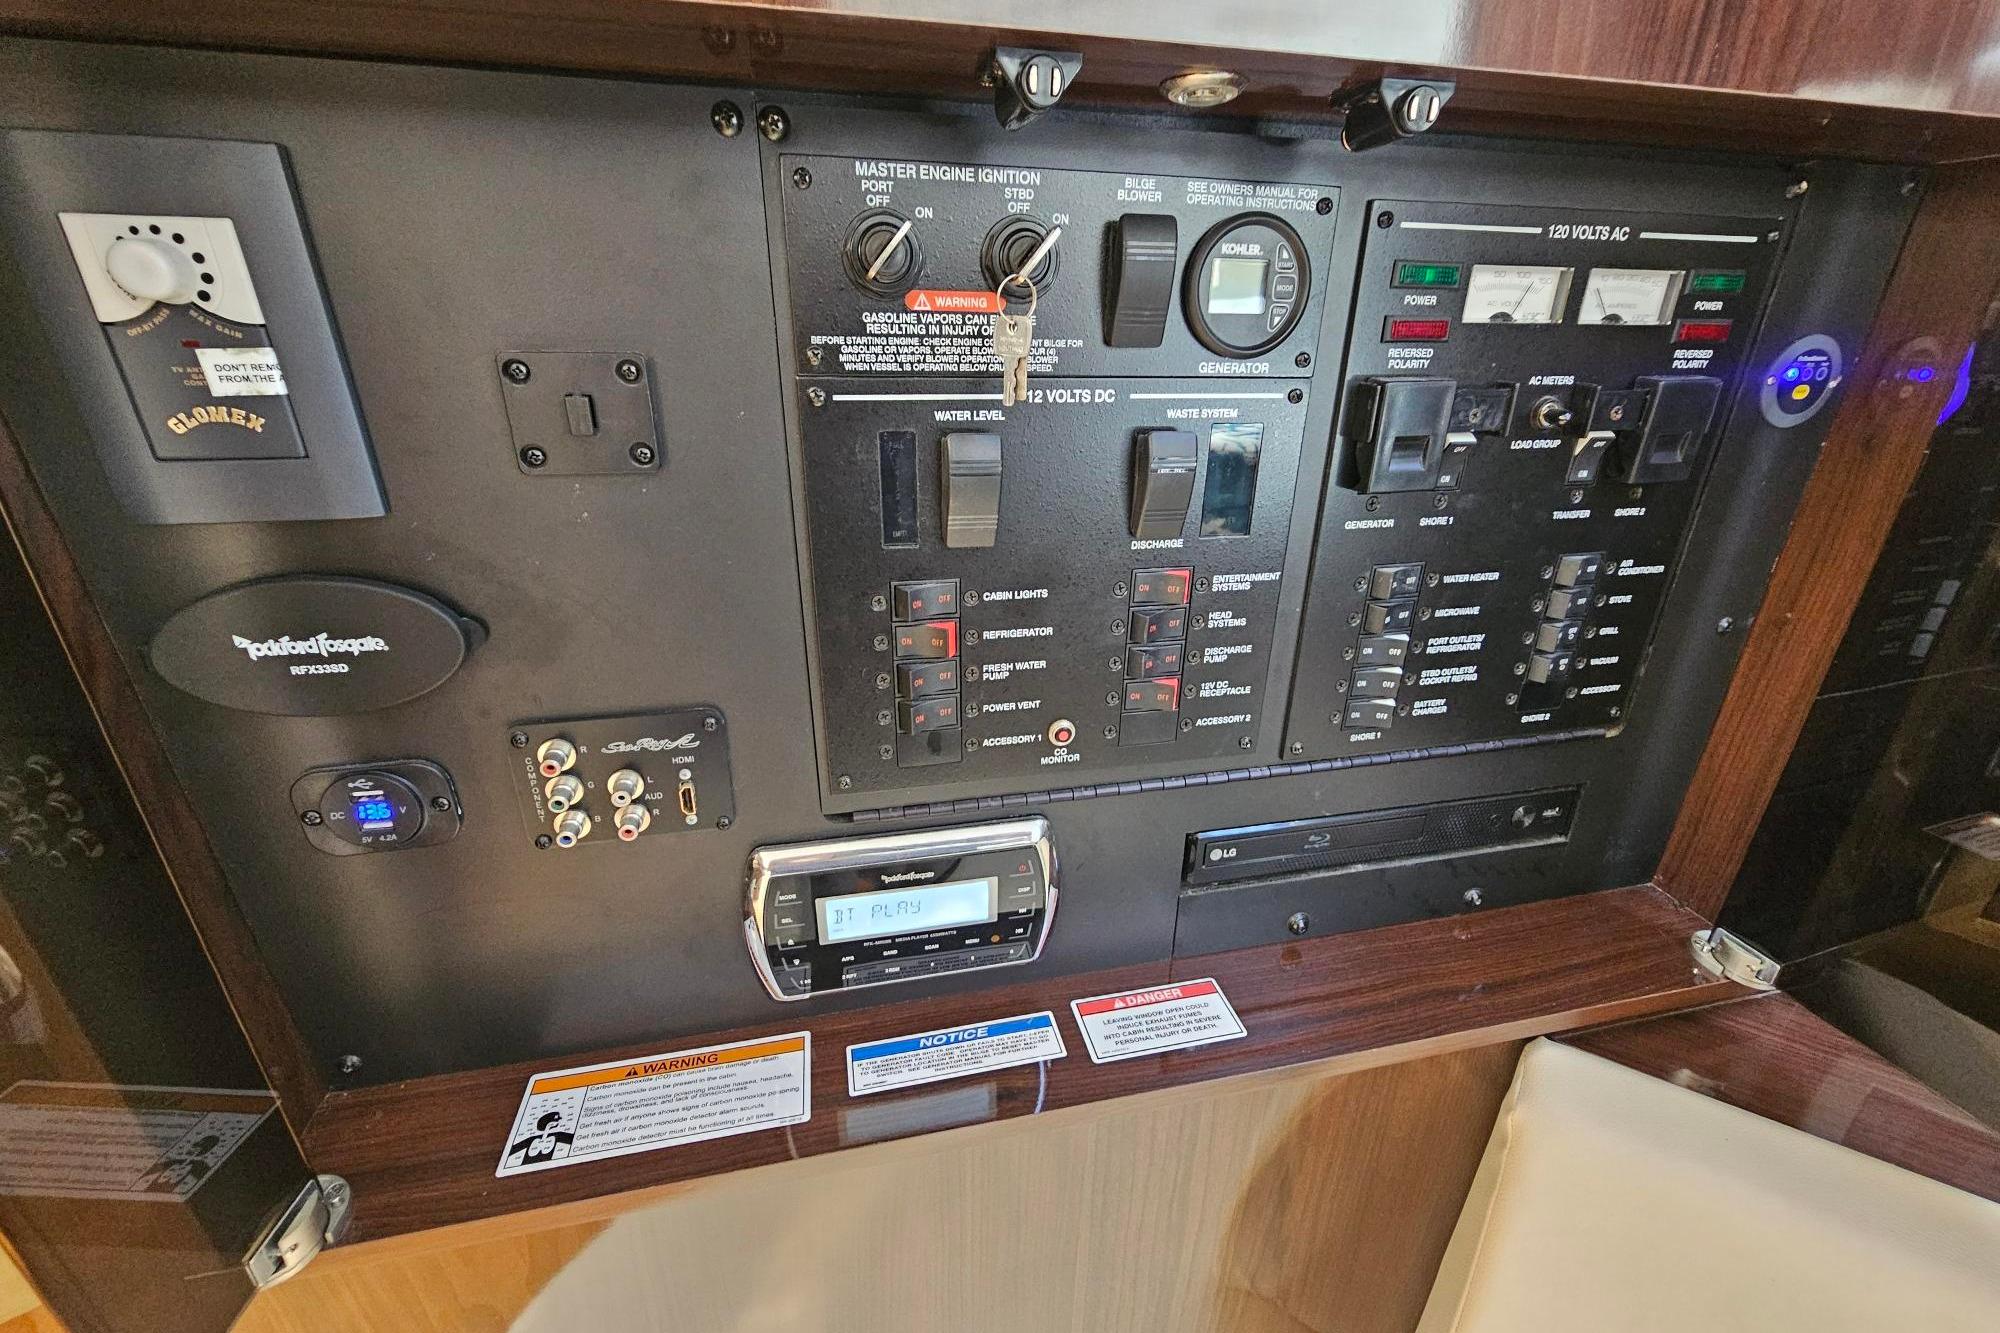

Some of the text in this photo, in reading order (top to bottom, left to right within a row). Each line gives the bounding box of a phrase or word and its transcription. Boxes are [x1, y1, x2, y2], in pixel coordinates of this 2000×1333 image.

[855, 161, 1040, 185] MASTER ENGINE IGNITION
[861, 180, 894, 193] PORT
[1125, 178, 1156, 190] BILGE
[1004, 188, 1034, 200] STBD
[1188, 182, 1318, 199] SEE OWNERS MANUAL FOR
[866, 196, 890, 207] OFF
[1118, 191, 1162, 202] BLOWER
[1008, 202, 1030, 214] OFF
[1187, 194, 1316, 211] OPERATING INSTRUCTIONS
[915, 207, 933, 219] ON
[1053, 213, 1069, 224] ON
[1549, 225, 1630, 241] 120 VOLTS AC
[1276, 284, 1293, 292] MODE
[935, 297, 987, 309] WARNING
[1404, 295, 1437, 305] POWER
[1694, 301, 1723, 311] POWER
[862, 312, 917, 323] GASOLINE
[920, 313, 963, 324] VAPORS
[965, 315, 988, 324] CAN
[867, 324, 980, 335] RESULTING IN INJURY
[811, 336, 845, 344] BEFORE
[846, 337, 887, 345] STARTING
[924, 338, 951, 346] CHECK
[953, 338, 982, 346] ENGINE
[1044, 340, 1066, 348] BILGE
[1068, 340, 1083, 348] FOR
[839, 354, 876, 362] MINUTES
[926, 355, 960, 363] BLOWER
[1388, 349, 1433, 358] REVERSED
[1674, 350, 1713, 359] REVERSED
[214, 364, 247, 372] DON'T
[844, 363, 870, 371] WHEN
[871, 363, 902, 371] VESSEL
[1199, 362, 1269, 374] GENERATOR
[1388, 360, 1430, 368] POLARITY
[1672, 360, 1709, 368] POLARITY
[218, 375, 251, 383] FROM
[1529, 375, 1574, 385] AC METERS
[1027, 389, 1116, 403] 12 VOLTS DC
[934, 410, 1005, 421] WATER LEVEL
[1167, 408, 1239, 418] WASTE SYSTEM
[167, 406, 265, 435] GLOMEX
[1511, 439, 1561, 449] LOAD GROUP
[1552, 510, 1591, 519] TRANSFER
[1615, 508, 1640, 517] SHORE
[1344, 519, 1394, 530] GENERATOR
[1420, 516, 1454, 526] SHORE 1
[1131, 539, 1184, 550] DISCHARGE
[1620, 559, 1634, 567] AIR
[1213, 572, 1281, 583] ENTERTAINMENT
[1443, 572, 1500, 583] WATER HEATER
[1212, 582, 1250, 592] SYSTEMS
[983, 589, 1048, 601] CABIN LIGHTS
[1209, 611, 1232, 619] HEAD
[1435, 606, 1480, 617] MICROWAVE
[1208, 618, 1246, 628] SYSTEMS
[983, 627, 1053, 640] REFRIGERATOR
[1428, 634, 1486, 646] PORT OUTLETS/
[1204, 645, 1252, 656] DISCHARGE
[1426, 643, 1481, 654] REFRIGERATOR
[1204, 655, 1227, 663] PUMP
[290, 664, 349, 676] RFX33SD
[983, 660, 1046, 673] FRESH WATER
[983, 672, 1009, 681] PUMP
[1421, 669, 1441, 678] STBD
[1201, 682, 1215, 690] 12V
[1419, 676, 1450, 685] COCKPIT
[1200, 686, 1251, 697] RECEPTACLE
[983, 700, 1041, 713] POWER VENT
[1414, 699, 1446, 708] BATTERY
[1412, 706, 1447, 716] CHARGER
[1196, 714, 1251, 726] ACCESSORY 2
[983, 734, 1042, 747] ACCESSORY 1
[1350, 733, 1375, 742] SHORE
[1054, 748, 1067, 756] CO
[672, 756, 695, 764] HDMI
[1041, 754, 1080, 765] MONITOR
[525, 757, 545, 824] COMPONENT
[588, 781, 595, 789] G
[645, 792, 663, 801] AUD
[330, 812, 346, 820] DC
[1223, 848, 1236, 858] LG
[871, 900, 921, 919] PLAY
[1127, 988, 1183, 1006] DANGER
[1103, 1016, 1133, 1025] LEAVING
[1135, 1011, 1163, 1019] WINDOW
[1165, 1007, 1184, 1015] OPEN
[1104, 1032, 1120, 1040] INTO
[1122, 1028, 1144, 1037] CABIN
[1146, 1022, 1184, 1032] RESULTING
[1194, 1014, 1221, 1023] SEVERE
[1117, 1022, 1143, 1030] INDUCE
[1145, 1016, 1178, 1025] EXHAUST
[920, 1027, 988, 1048] NOTICE
[1115, 1036, 1154, 1046] PERSONAL
[1155, 1031, 1180, 1039] INJURY
[643, 1053, 718, 1074] WARNING
